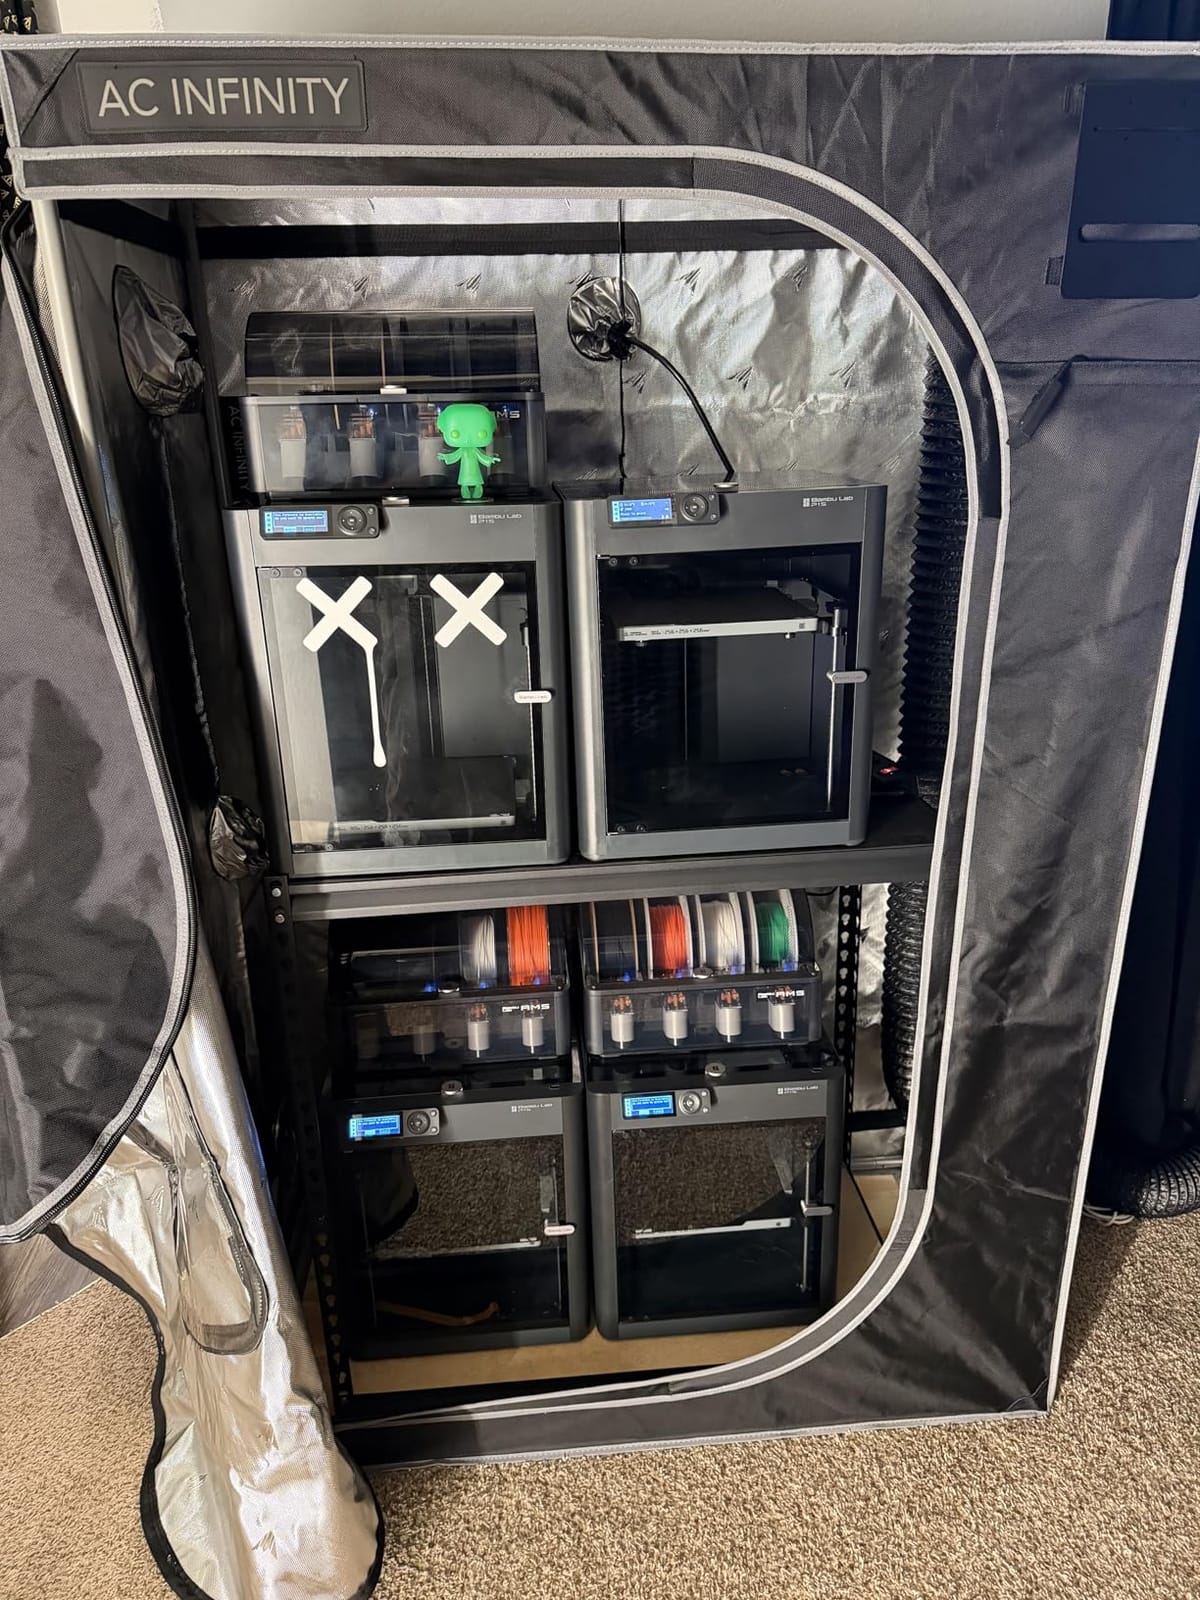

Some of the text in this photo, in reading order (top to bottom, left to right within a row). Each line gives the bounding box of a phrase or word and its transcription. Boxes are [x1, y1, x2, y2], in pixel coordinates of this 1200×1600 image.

[98, 77, 349, 117] AC INFINITY
[775, 990, 805, 998] AMS
[520, 1003, 550, 1012] AMS
